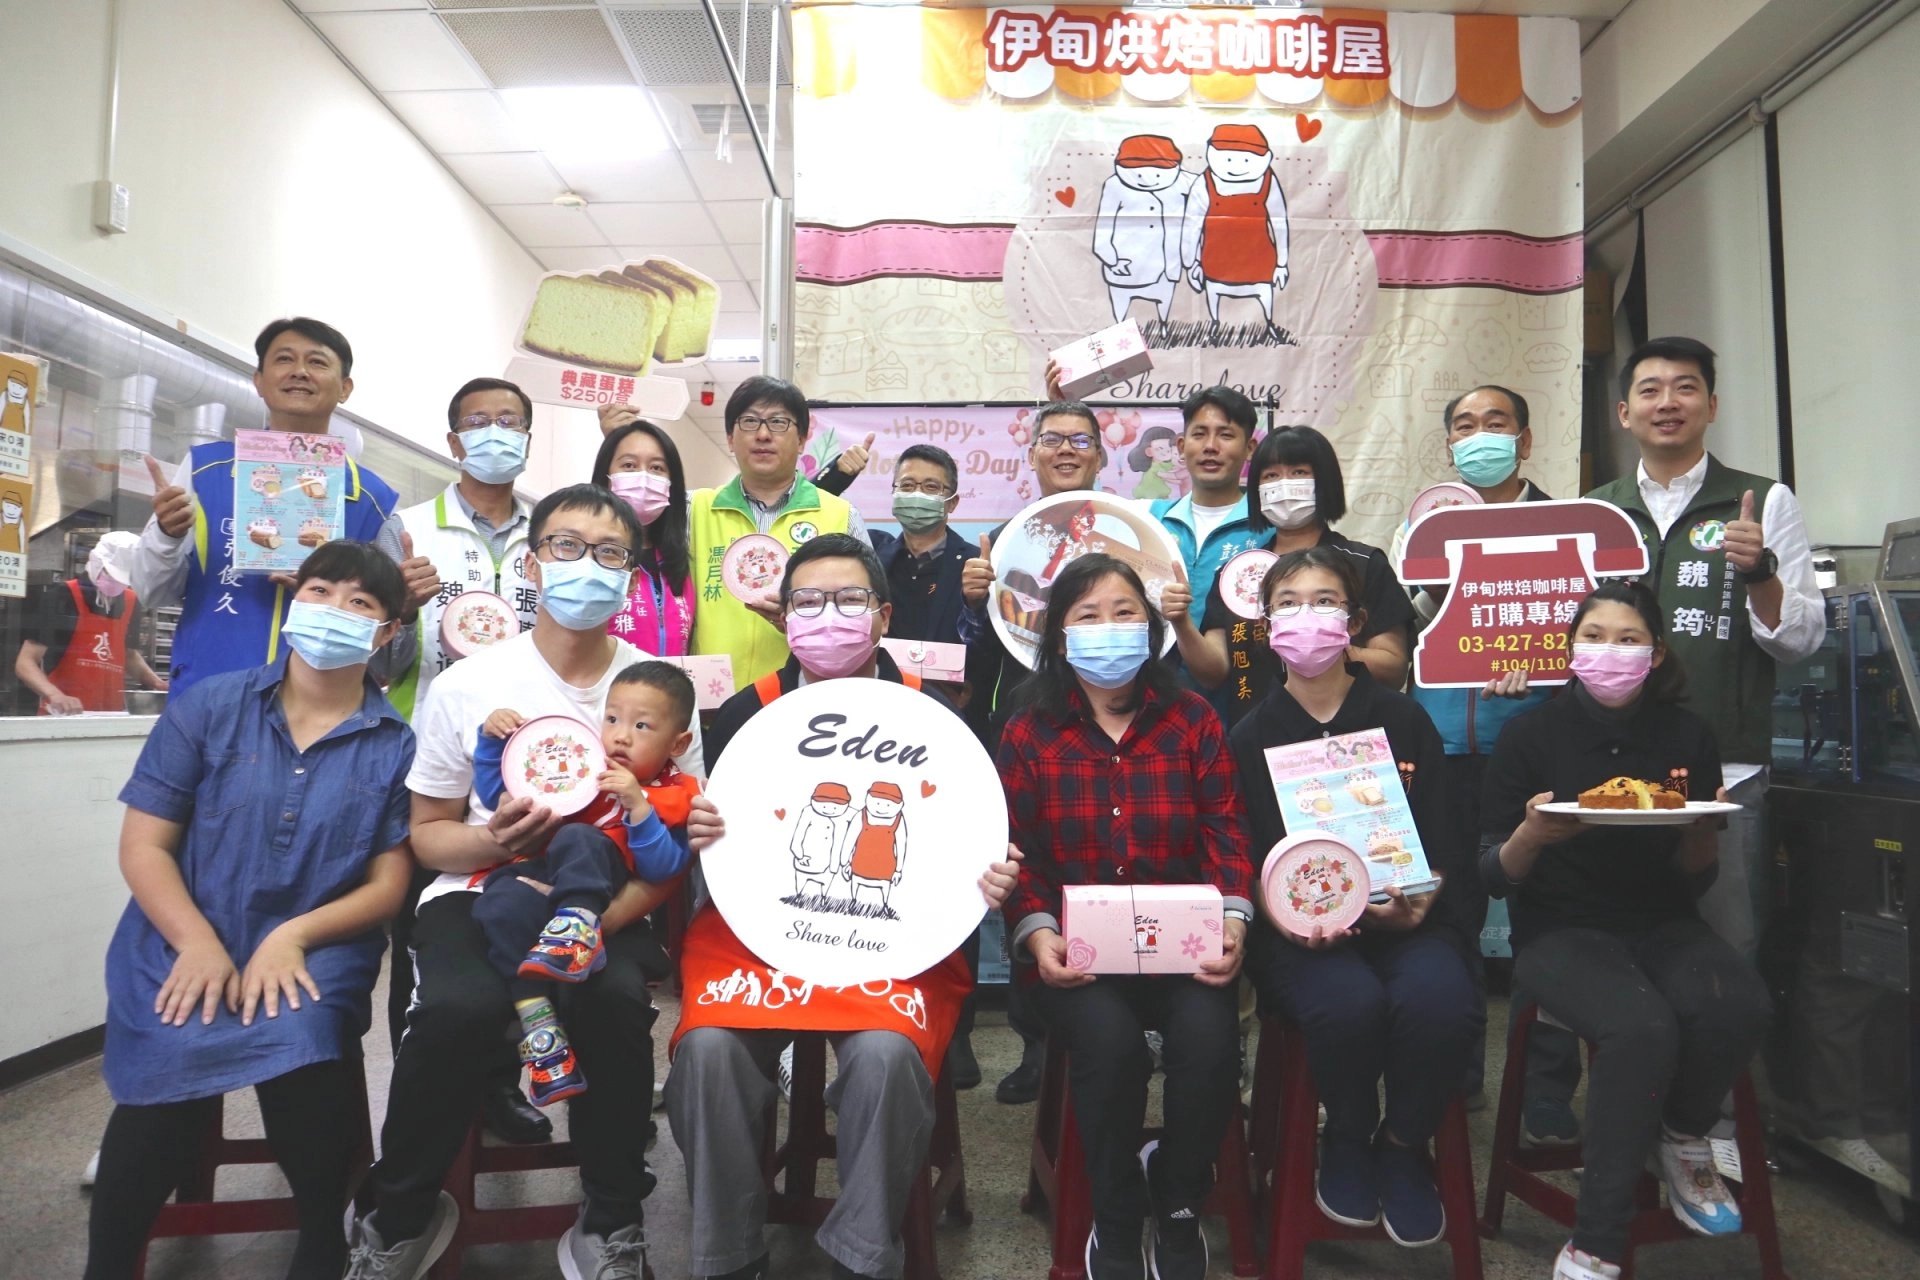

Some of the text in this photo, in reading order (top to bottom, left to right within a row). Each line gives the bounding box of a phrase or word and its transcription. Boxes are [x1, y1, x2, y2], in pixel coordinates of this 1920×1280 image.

[989, 15, 1384, 75] 伊甸烘焙咖啡屋
[561, 369, 635, 395] 典藏蛋糕
[893, 416, 975, 443] Happy
[966, 450, 1021, 482] Day
[465, 550, 482, 582] 特助
[634, 583, 648, 617] 主任
[1461, 577, 1587, 598] 伊甸烘焙咖啡屋
[1470, 600, 1579, 628] 訂購專線
[1458, 632, 1568, 654] 03-427-82
[1231, 622, 1252, 700] 張旭美
[1491, 657, 1567, 673] #104/110
[544, 744, 568, 754] Eden
[797, 713, 929, 768] Eden
[1303, 866, 1327, 880] Eden
[1134, 915, 1160, 926] Eden
[785, 919, 889, 953] Share love
